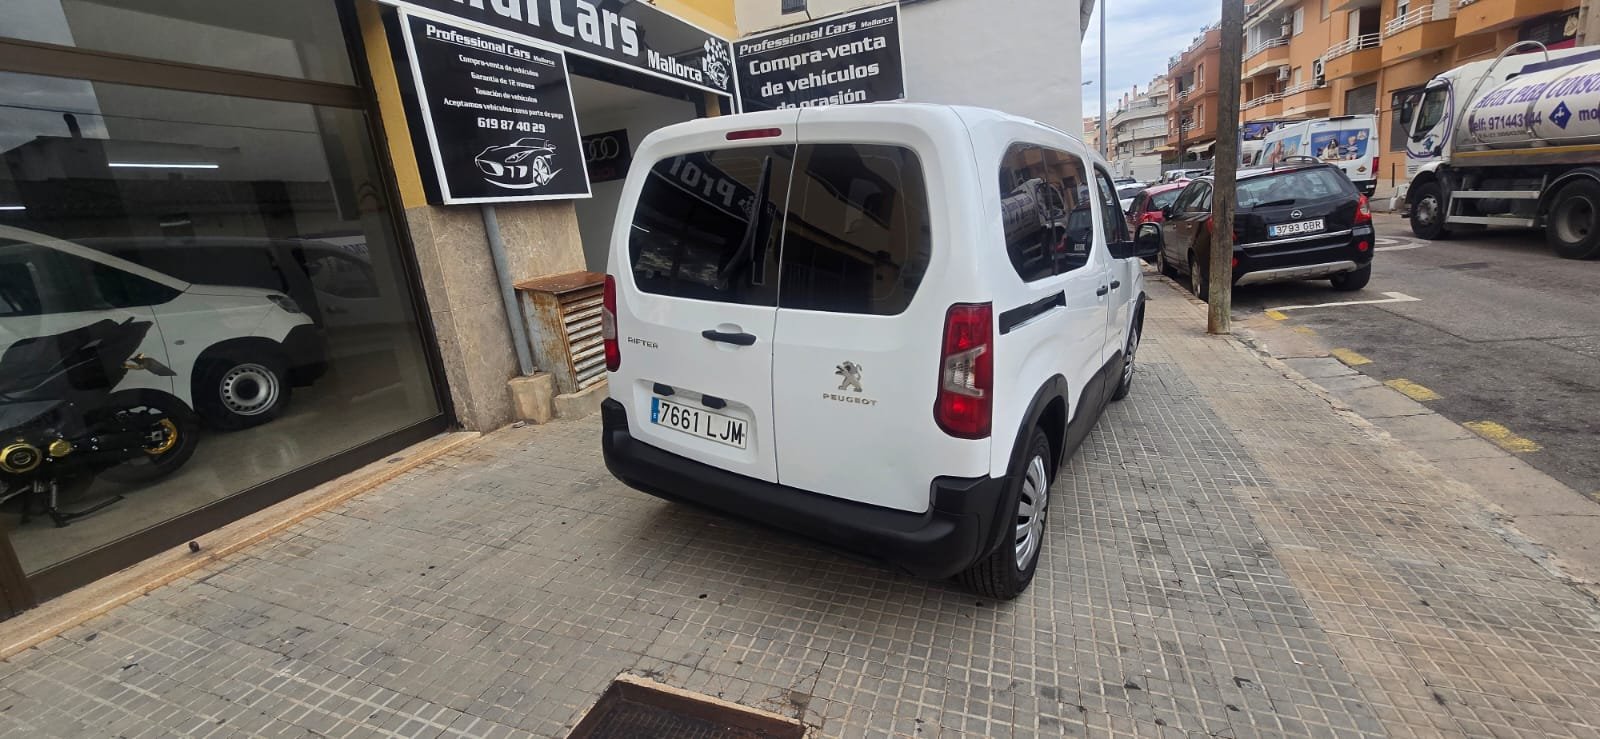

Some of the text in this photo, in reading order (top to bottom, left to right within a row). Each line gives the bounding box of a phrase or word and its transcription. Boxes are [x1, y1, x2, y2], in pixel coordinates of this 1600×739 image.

[426, 24, 506, 54] Professional
[507, 45, 531, 60] Cars
[739, 16, 894, 55] Professional Cars Mallorca
[647, 49, 703, 82] Mallorca
[749, 36, 887, 76] Compra-venta
[505, 64, 513, 72] de
[509, 79, 516, 87] 12
[761, 63, 880, 97] de vehículos
[443, 97, 482, 111] Aceptamos
[512, 107, 528, 115] como
[800, 88, 867, 110] ocasión
[477, 117, 546, 134] 619 87 40 29
[627, 336, 659, 349] RIFTER
[823, 393, 877, 406] PEUGEOT
[661, 403, 699, 433] 7661
[706, 415, 743, 445] LJM
